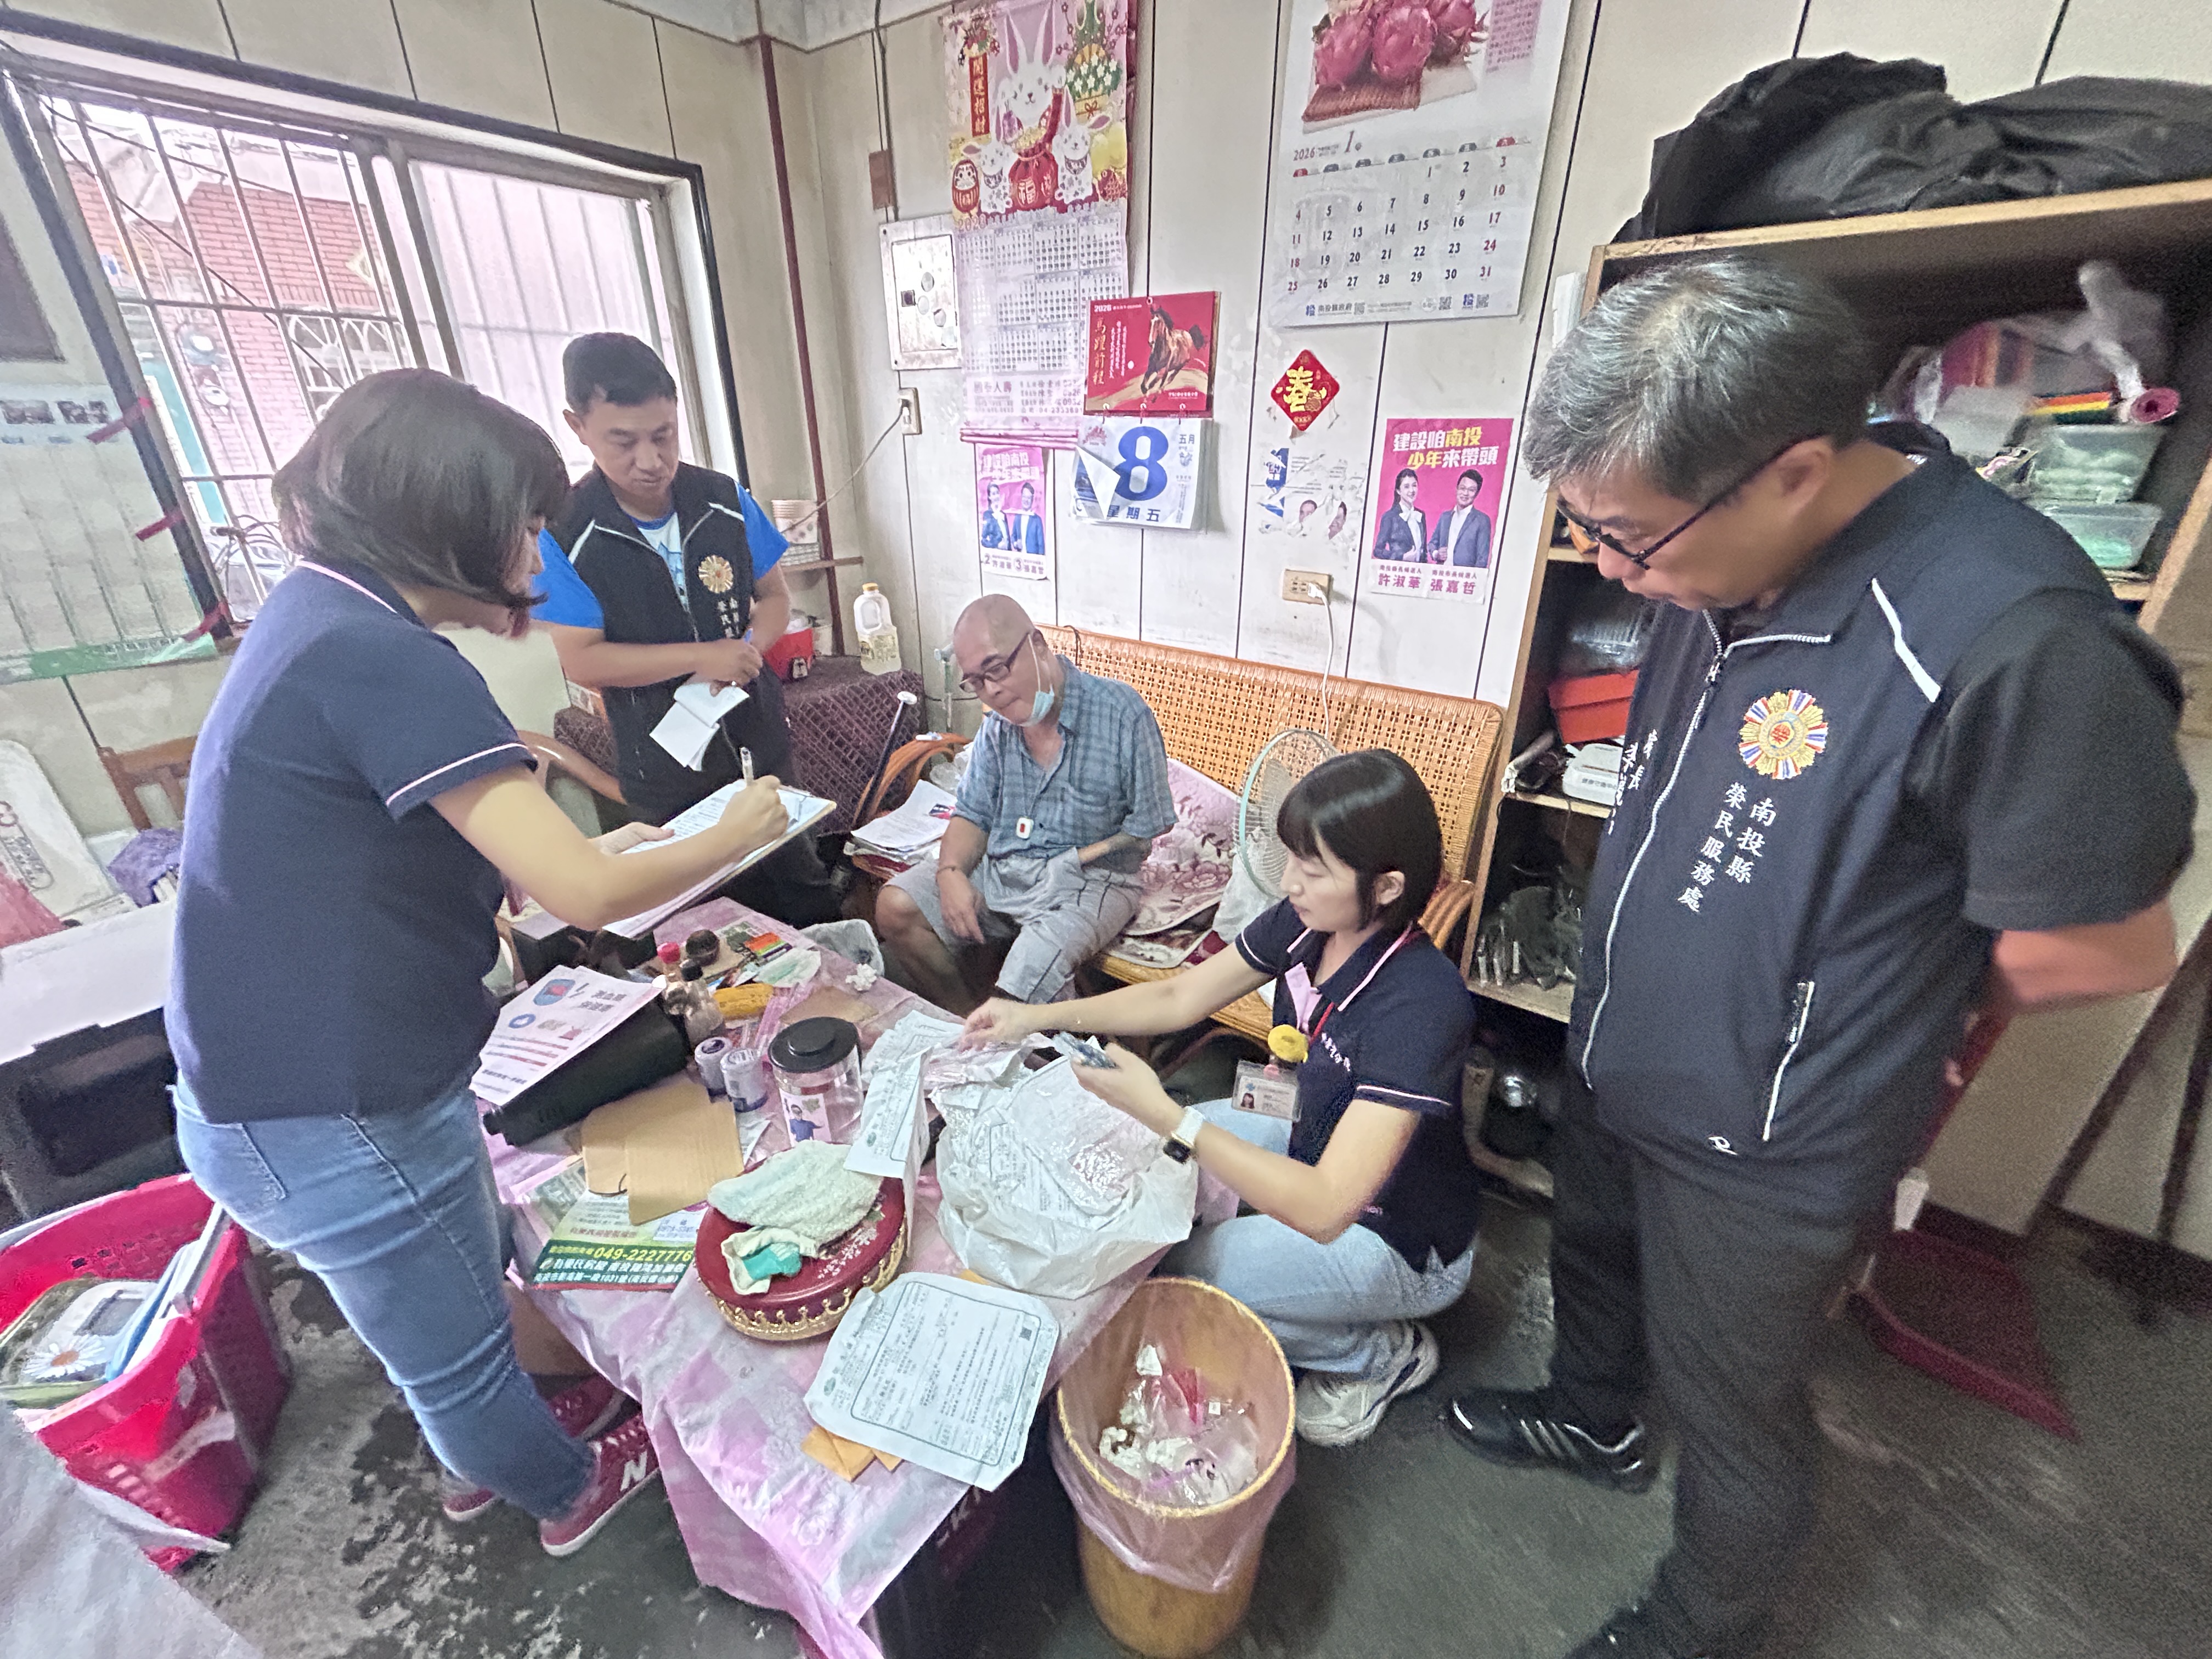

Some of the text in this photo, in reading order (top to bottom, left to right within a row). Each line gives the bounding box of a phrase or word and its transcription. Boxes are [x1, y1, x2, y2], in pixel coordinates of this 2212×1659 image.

[1293, 146, 1315, 161] 2026
[1428, 156, 1506, 178] 1 2 3
[1018, 179, 1036, 204] 福
[1296, 184, 1505, 221] 4 5 6 7 8 9 10
[1293, 211, 1501, 244] 11 12 13 14 15 16 17
[1291, 239, 1497, 268] 18 19 20 21 22 23 24
[1288, 266, 1491, 291] 25 26 27 28 29 30 31
[1318, 303, 1352, 312] 南投縣政府
[1093, 317, 1106, 385] 馬躍前程
[1283, 365, 1316, 413] 春
[1178, 434, 1195, 444] 五月
[1392, 426, 1482, 452] 建設咱南投
[1114, 426, 1169, 501] 8
[1407, 445, 1499, 469] 少年來帶頭
[1107, 505, 1160, 522] 星期五
[1378, 573, 1421, 589] 許淑華
[1431, 578, 1476, 595] 張嘉哲
[1677, 782, 1747, 913] 榮民服務處
[1725, 798, 1776, 883] 南投縣
[594, 1247, 693, 1262] 049-2227776
[620, 1451, 648, 1491] N
